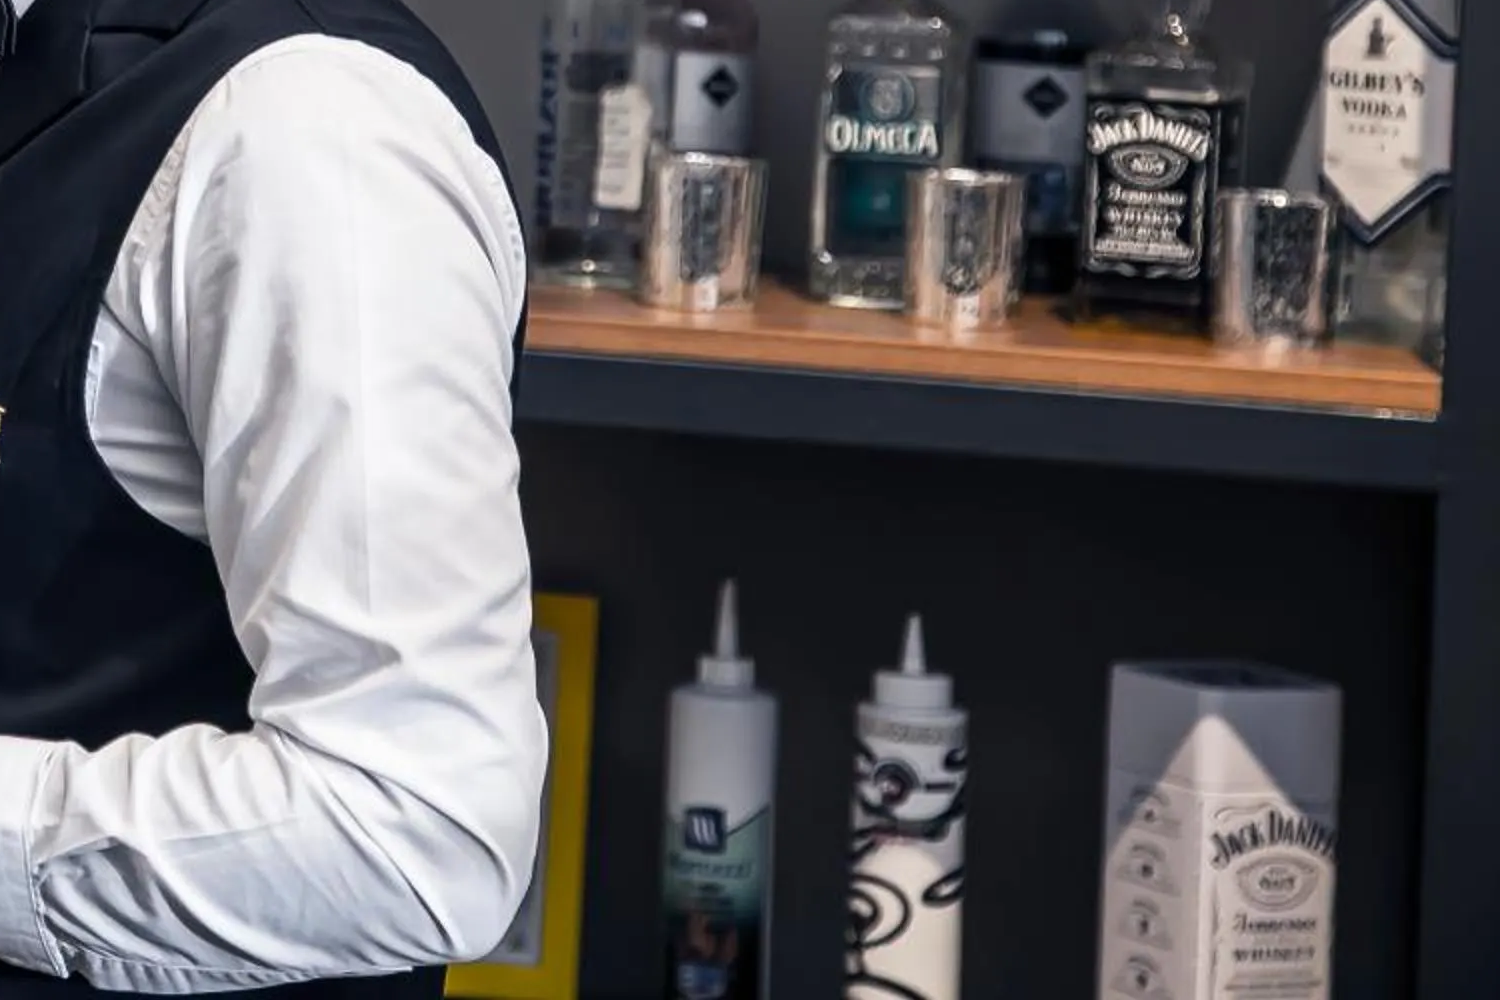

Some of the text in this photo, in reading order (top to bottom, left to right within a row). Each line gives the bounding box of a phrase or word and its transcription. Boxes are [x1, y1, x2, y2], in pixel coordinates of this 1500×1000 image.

[1329, 70, 1426, 98] GILBEY'S
[1341, 96, 1407, 119] VODKA
[825, 114, 940, 158] OLMECA
[1211, 822, 1266, 871] JACK
